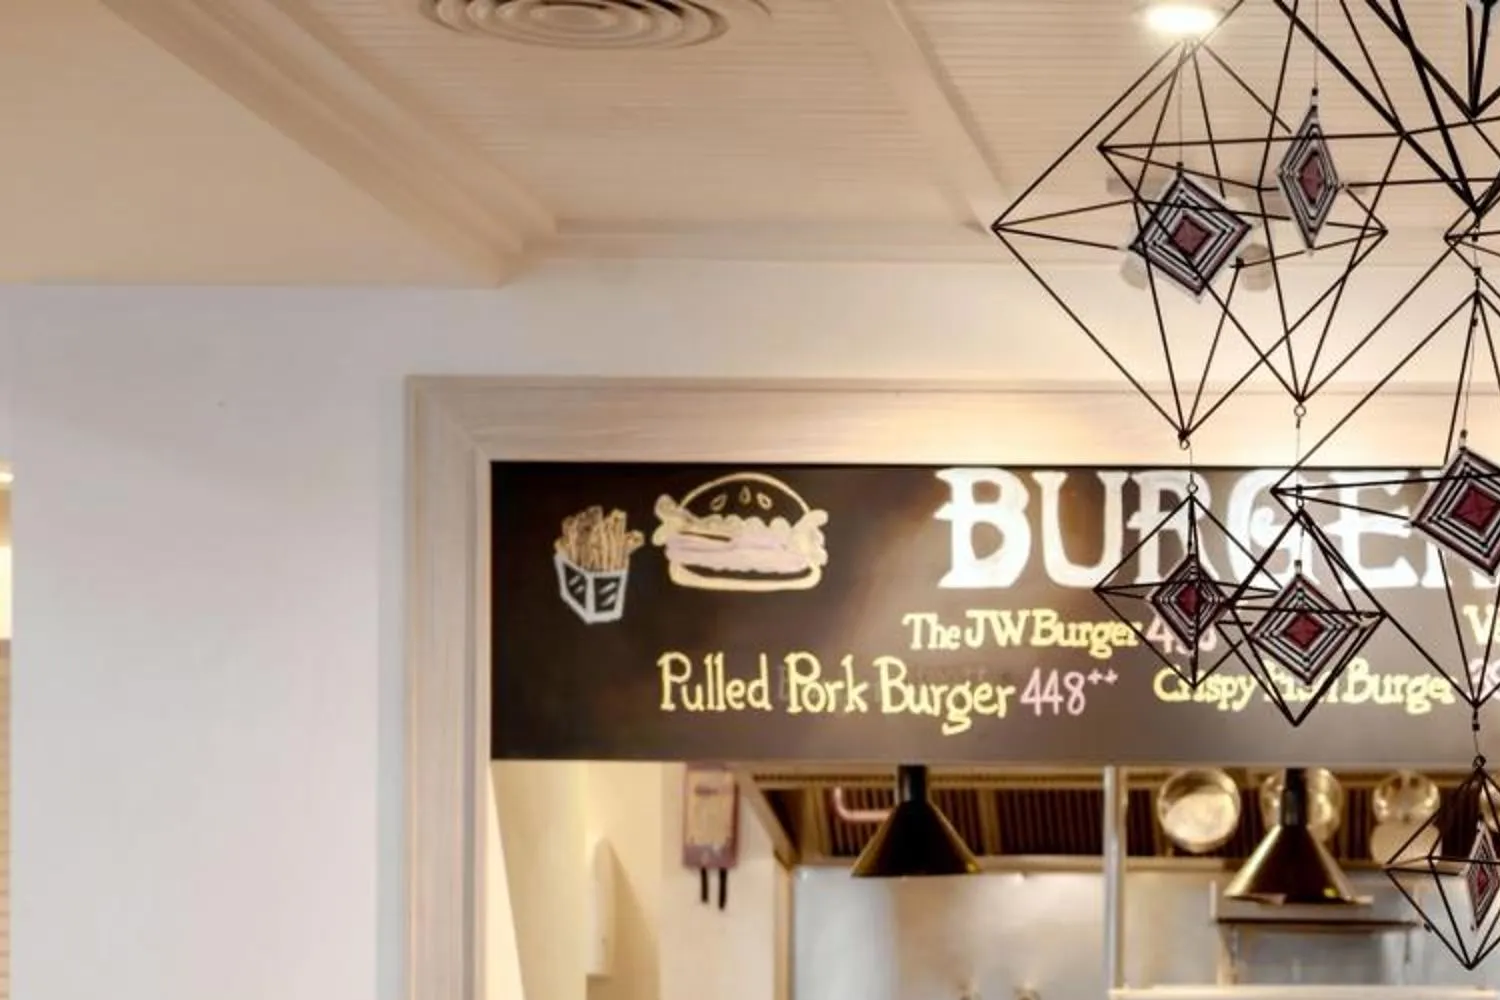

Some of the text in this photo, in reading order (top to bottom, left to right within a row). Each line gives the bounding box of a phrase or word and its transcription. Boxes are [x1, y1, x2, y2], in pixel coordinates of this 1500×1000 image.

[901, 612, 961, 650] The
[965, 609, 1030, 648] JW
[1031, 608, 1142, 658] Burger
[656, 651, 774, 712] Pulled
[784, 651, 870, 713] Pork
[872, 655, 1016, 736] Burger
